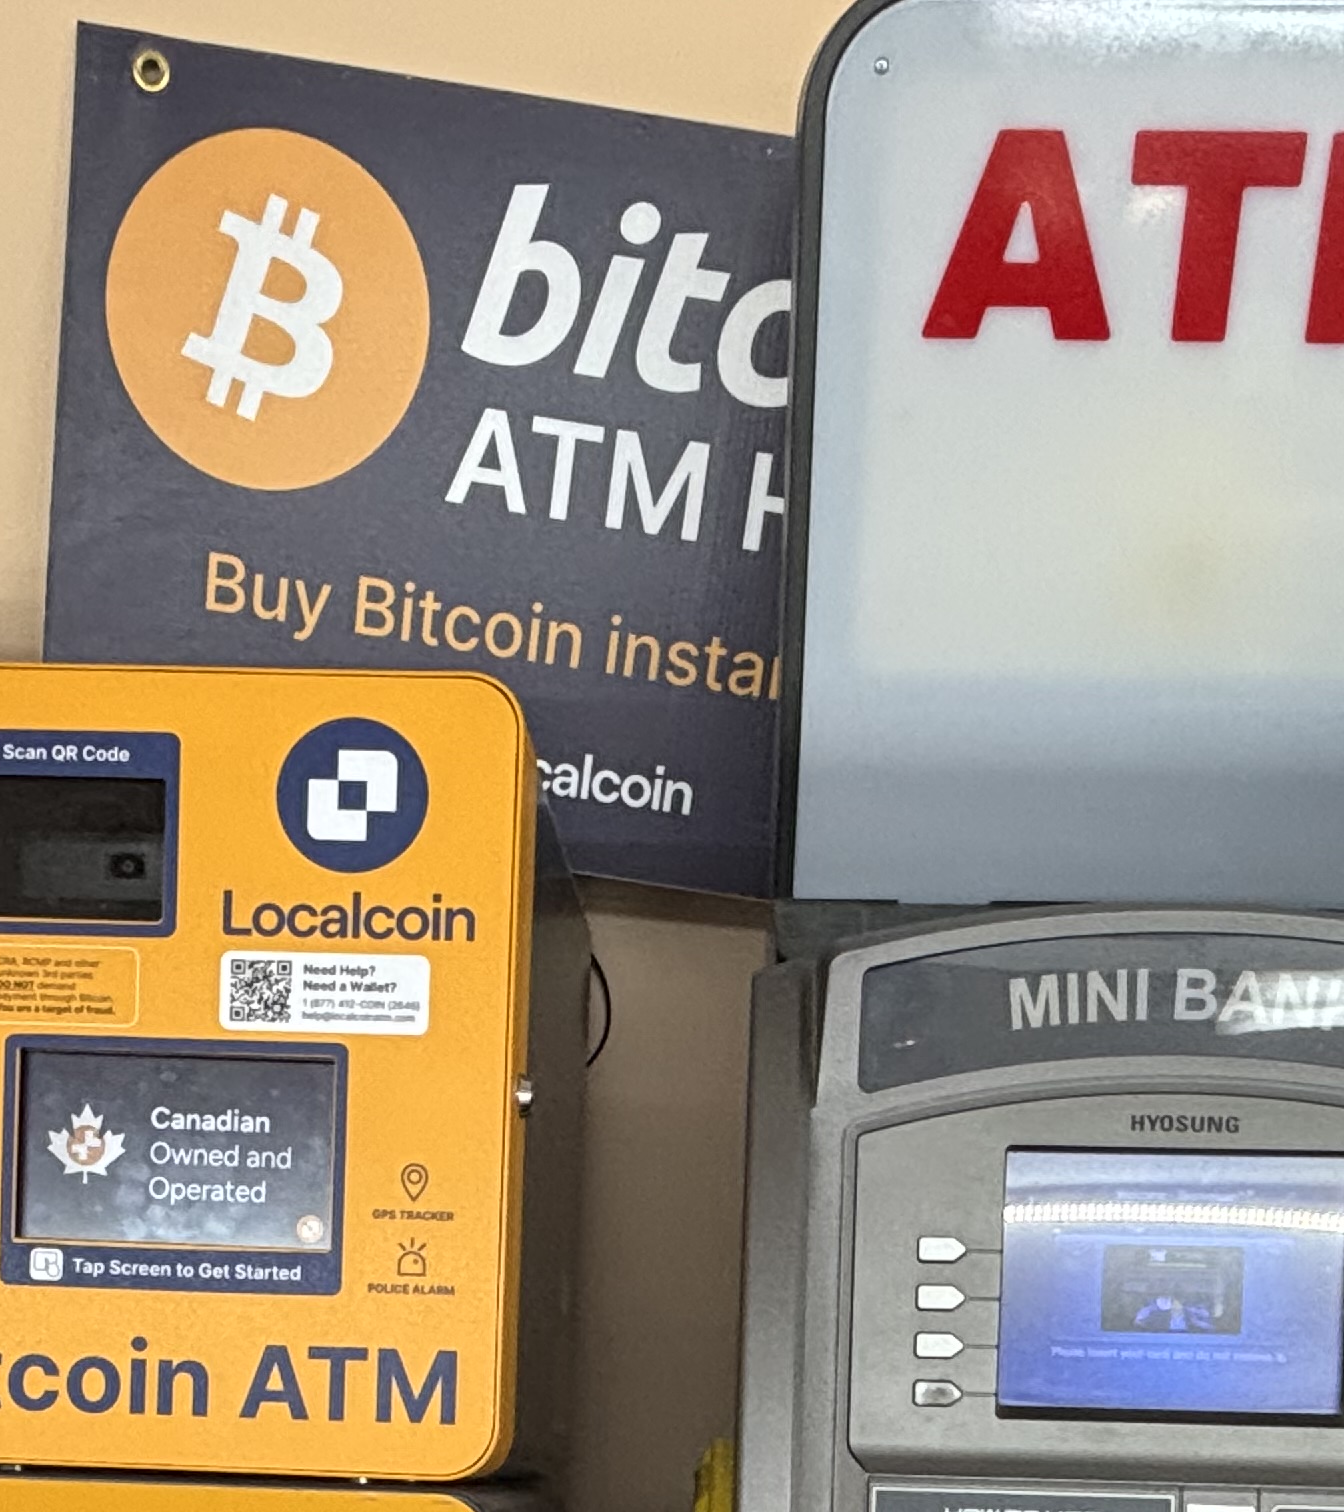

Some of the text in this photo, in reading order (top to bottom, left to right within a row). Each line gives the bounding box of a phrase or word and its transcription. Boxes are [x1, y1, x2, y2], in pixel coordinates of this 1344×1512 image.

[460, 184, 791, 408] bitc
[445, 408, 713, 541] ATM
[206, 552, 330, 641] Buy
[355, 575, 581, 669] Bitcoin
[2, 744, 131, 762] Scan QR Code
[222, 890, 476, 943] Localcoin
[303, 964, 376, 978] Need Help?
[14, 981, 34, 990] NOT
[303, 980, 397, 993] Need a Wallet?
[42, 1005, 72, 1015] target
[75, 1005, 84, 1013] of
[1008, 968, 1150, 1031] MINI
[151, 1106, 270, 1134] Canadian
[1130, 1114, 1240, 1134] HYOSUNG
[150, 1141, 293, 1171] Owned and
[149, 1176, 267, 1204] Operated
[372, 1208, 454, 1221] GPS TRACKER
[73, 1258, 302, 1281] Tap Screen to Get Started
[367, 1283, 455, 1295] POLICE ALARM
[239, 1343, 457, 1425] ATM
